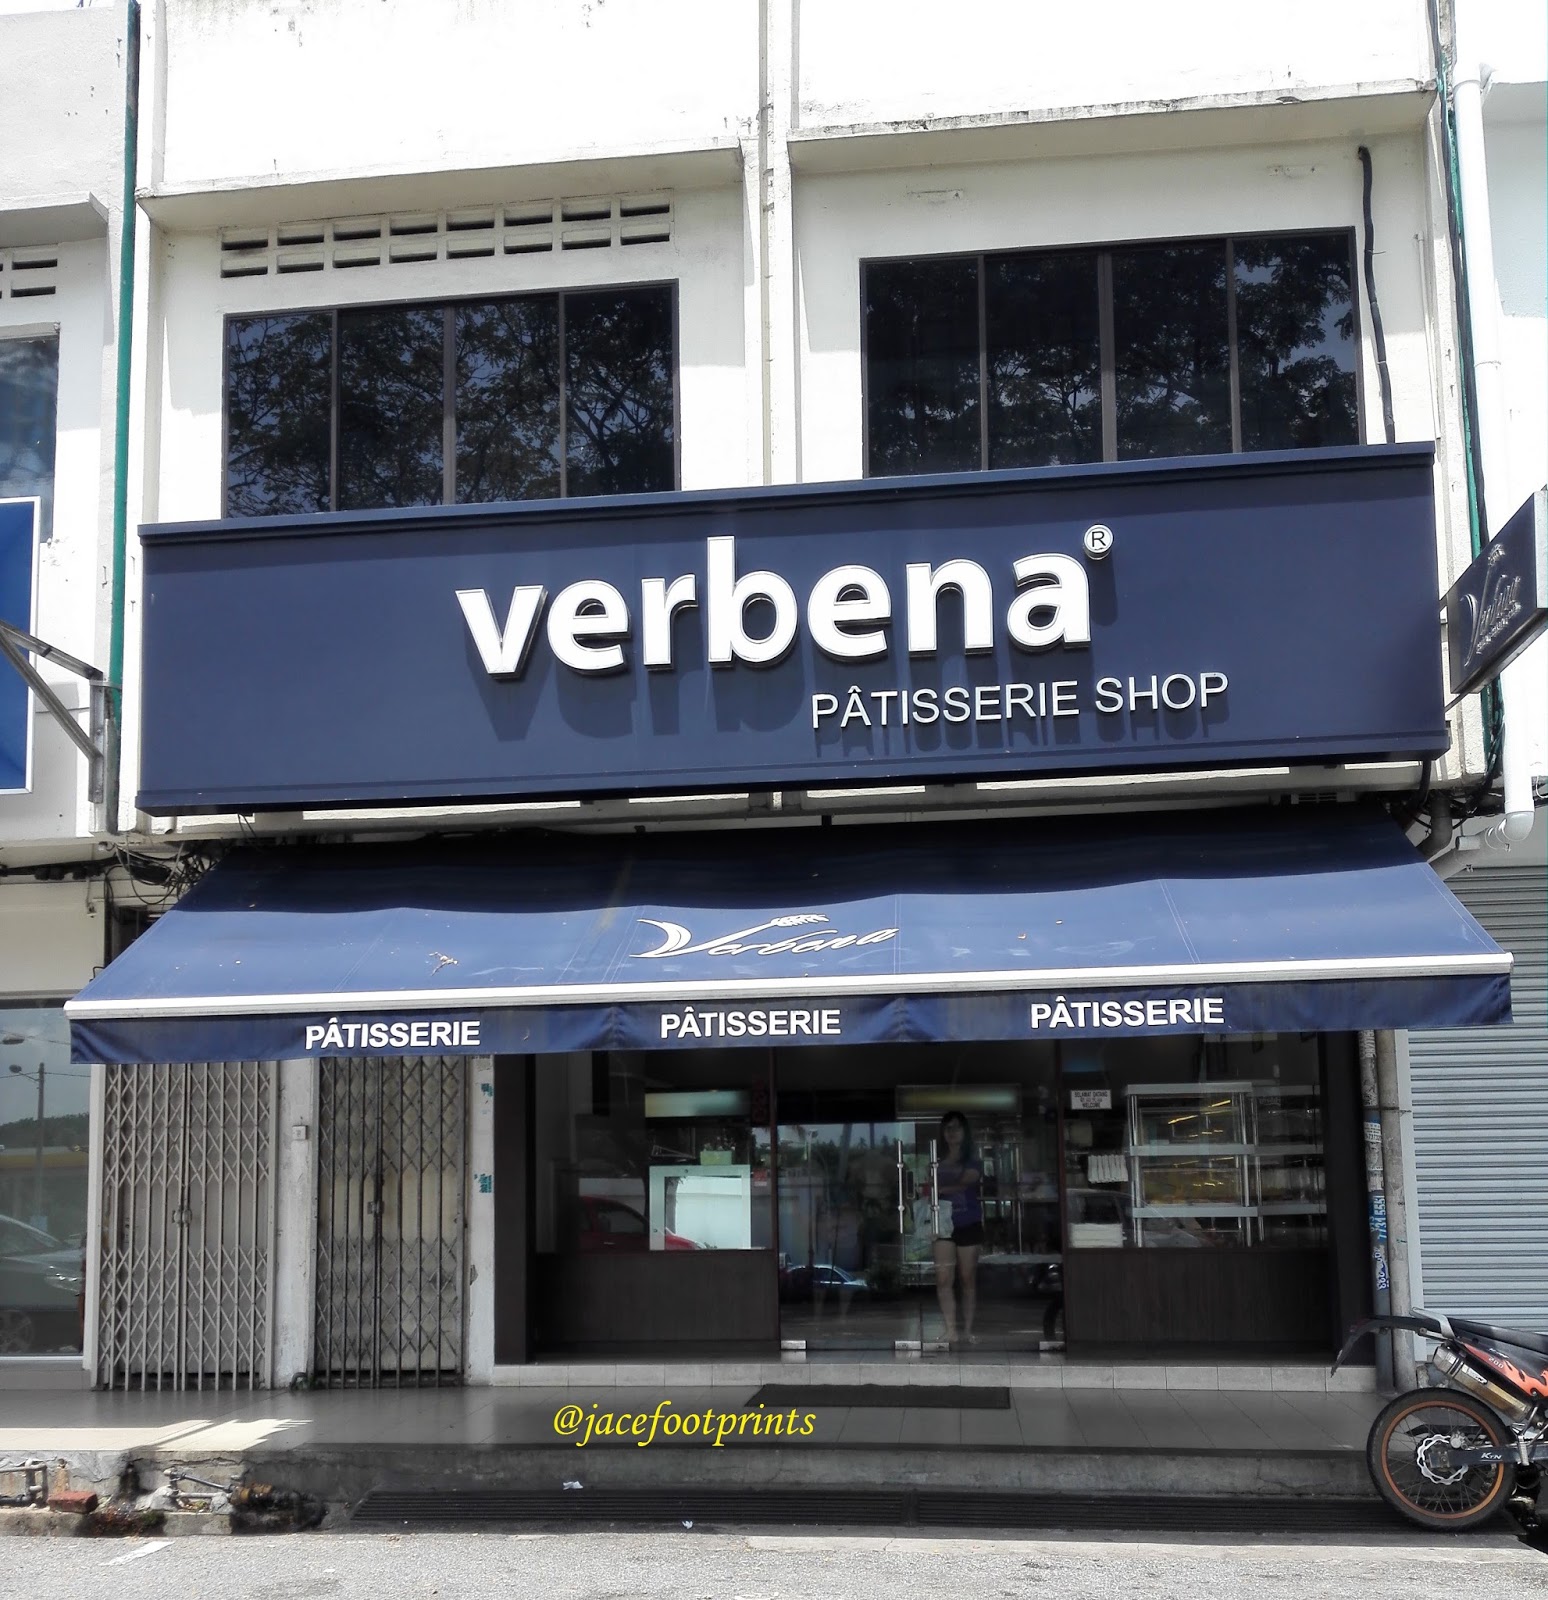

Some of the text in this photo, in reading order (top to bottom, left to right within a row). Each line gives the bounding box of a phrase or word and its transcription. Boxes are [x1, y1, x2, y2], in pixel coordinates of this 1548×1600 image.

[455, 536, 1091, 676] verbena
[811, 671, 1229, 730] PÂTISSERIE SHOP
[660, 1006, 842, 1039] PÂTISSERIE
[1030, 995, 1225, 1029] PÂTISSERIE
[305, 1017, 481, 1050] PÂTISSERIE
